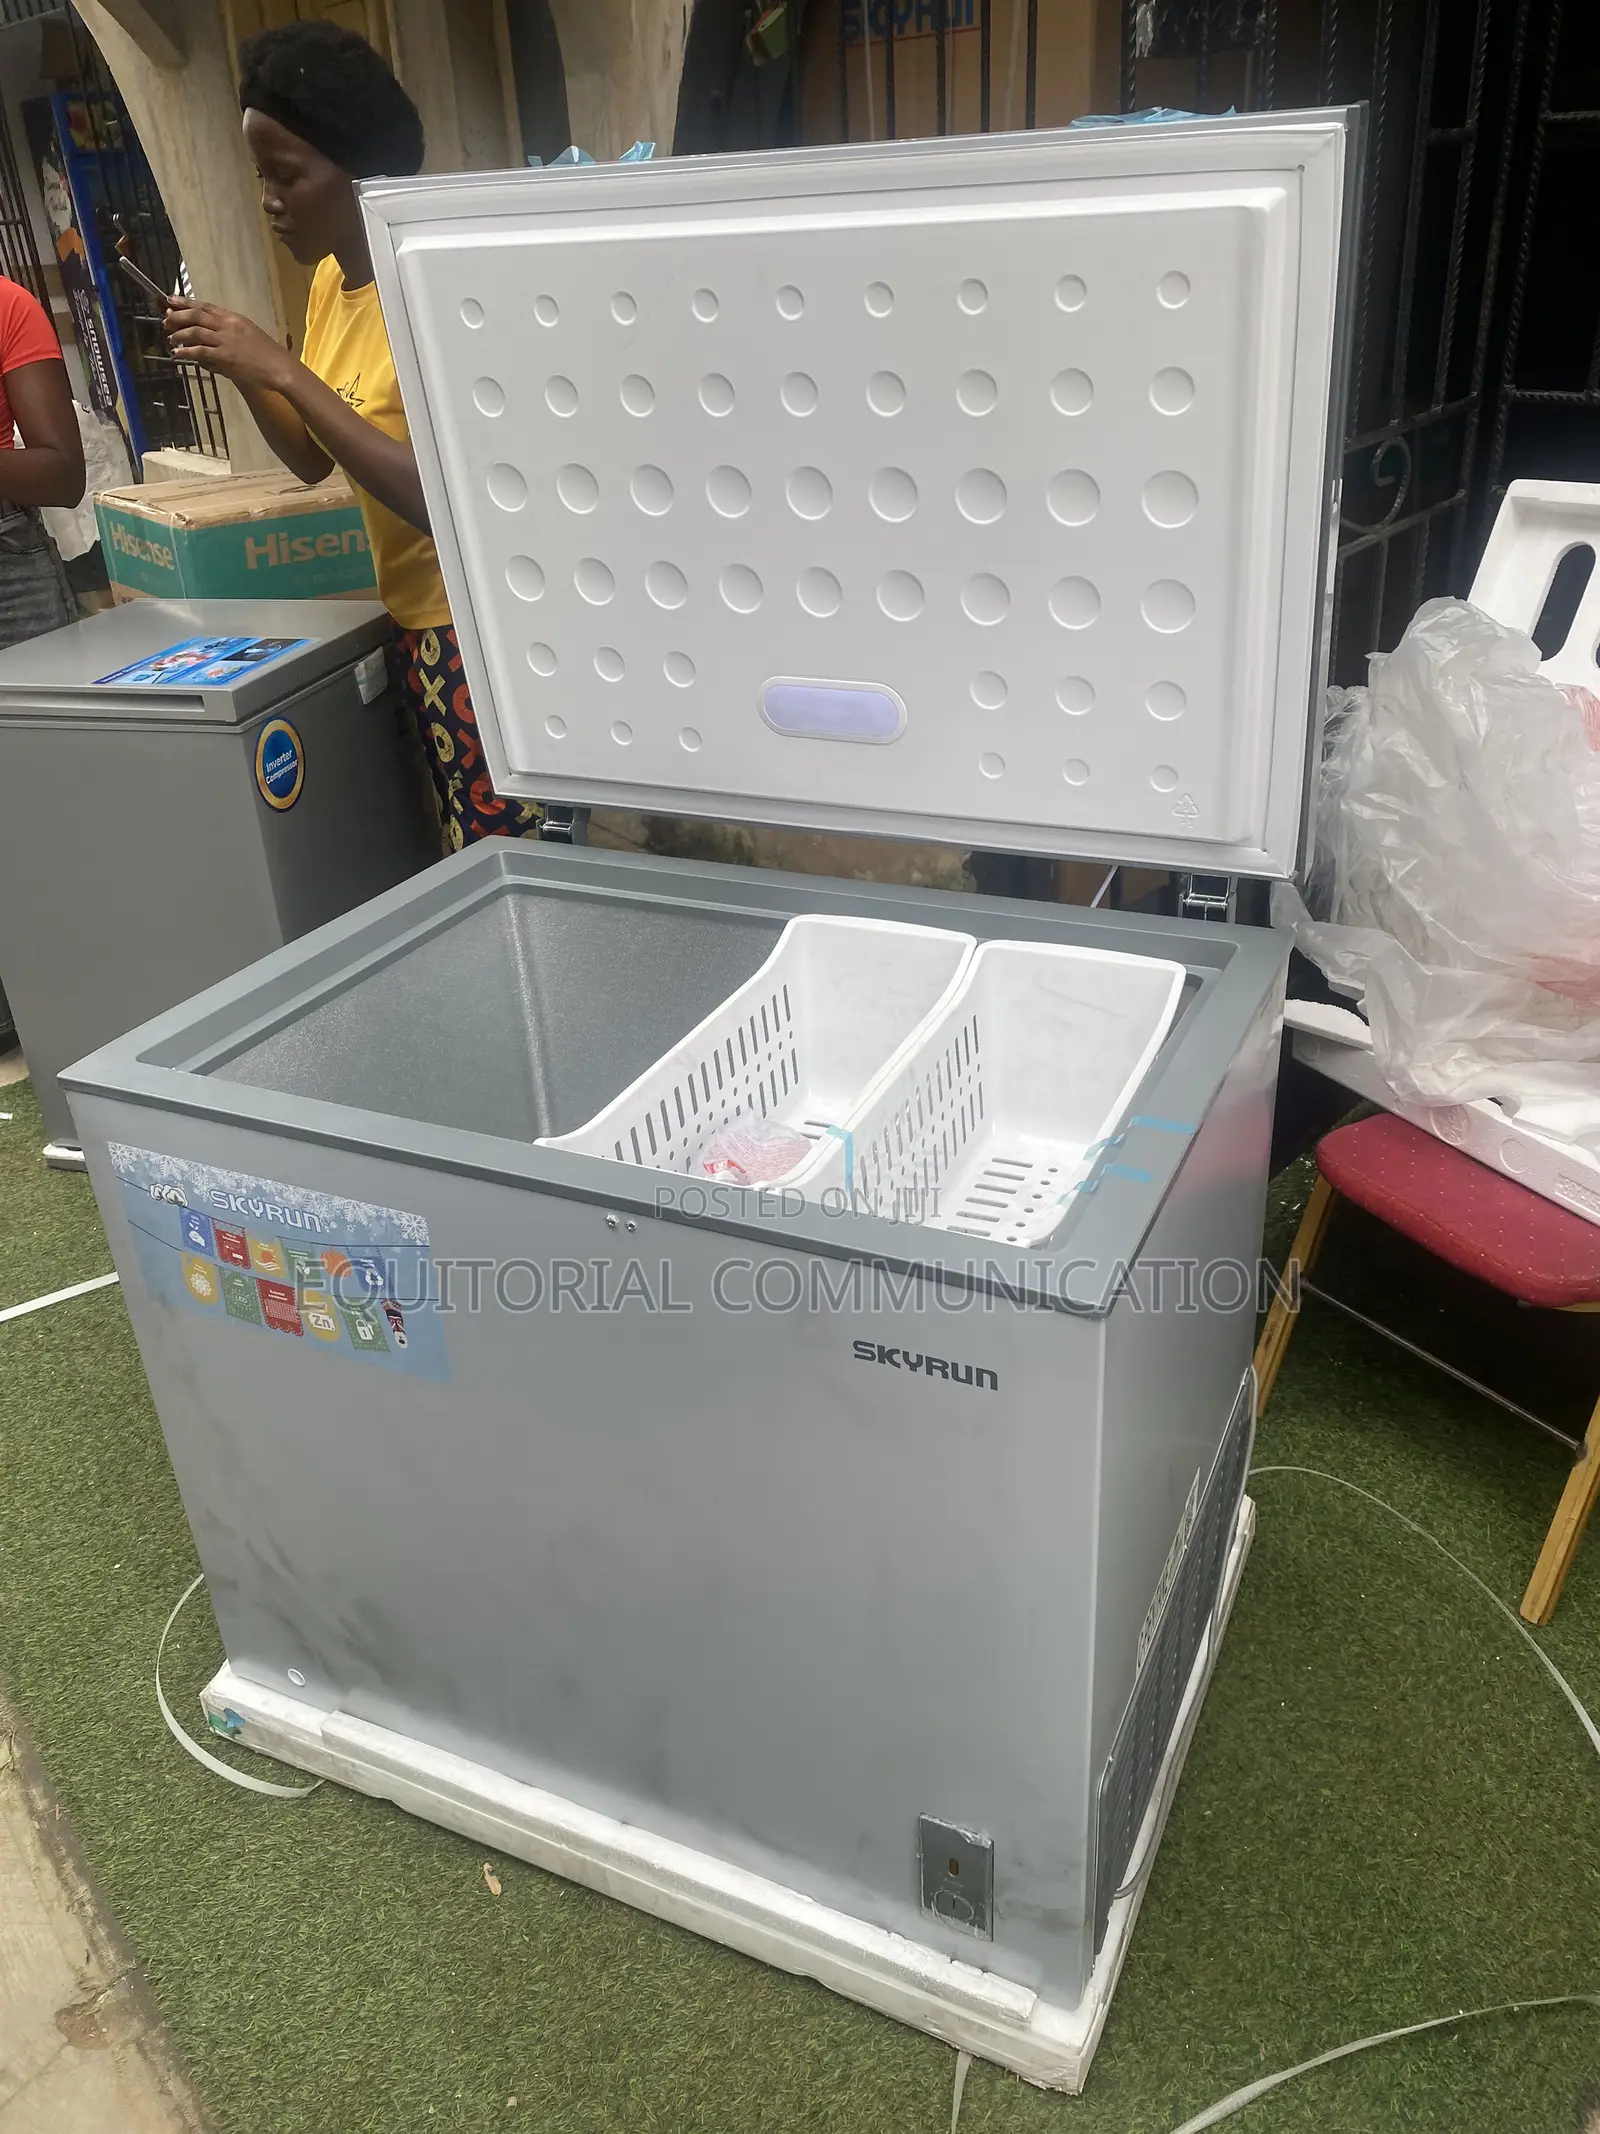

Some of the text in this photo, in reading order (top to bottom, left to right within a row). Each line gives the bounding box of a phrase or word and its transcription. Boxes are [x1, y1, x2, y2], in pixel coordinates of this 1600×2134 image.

[245, 529, 371, 570] Hisen
[265, 759, 298, 785] Compressor
[266, 749, 293, 773] Inverter
[209, 1189, 323, 1233] SKYRUN
[234, 1294, 249, 1305] LED
[312, 1314, 332, 1329] Zn
[852, 1340, 998, 1391] SKYRUN
